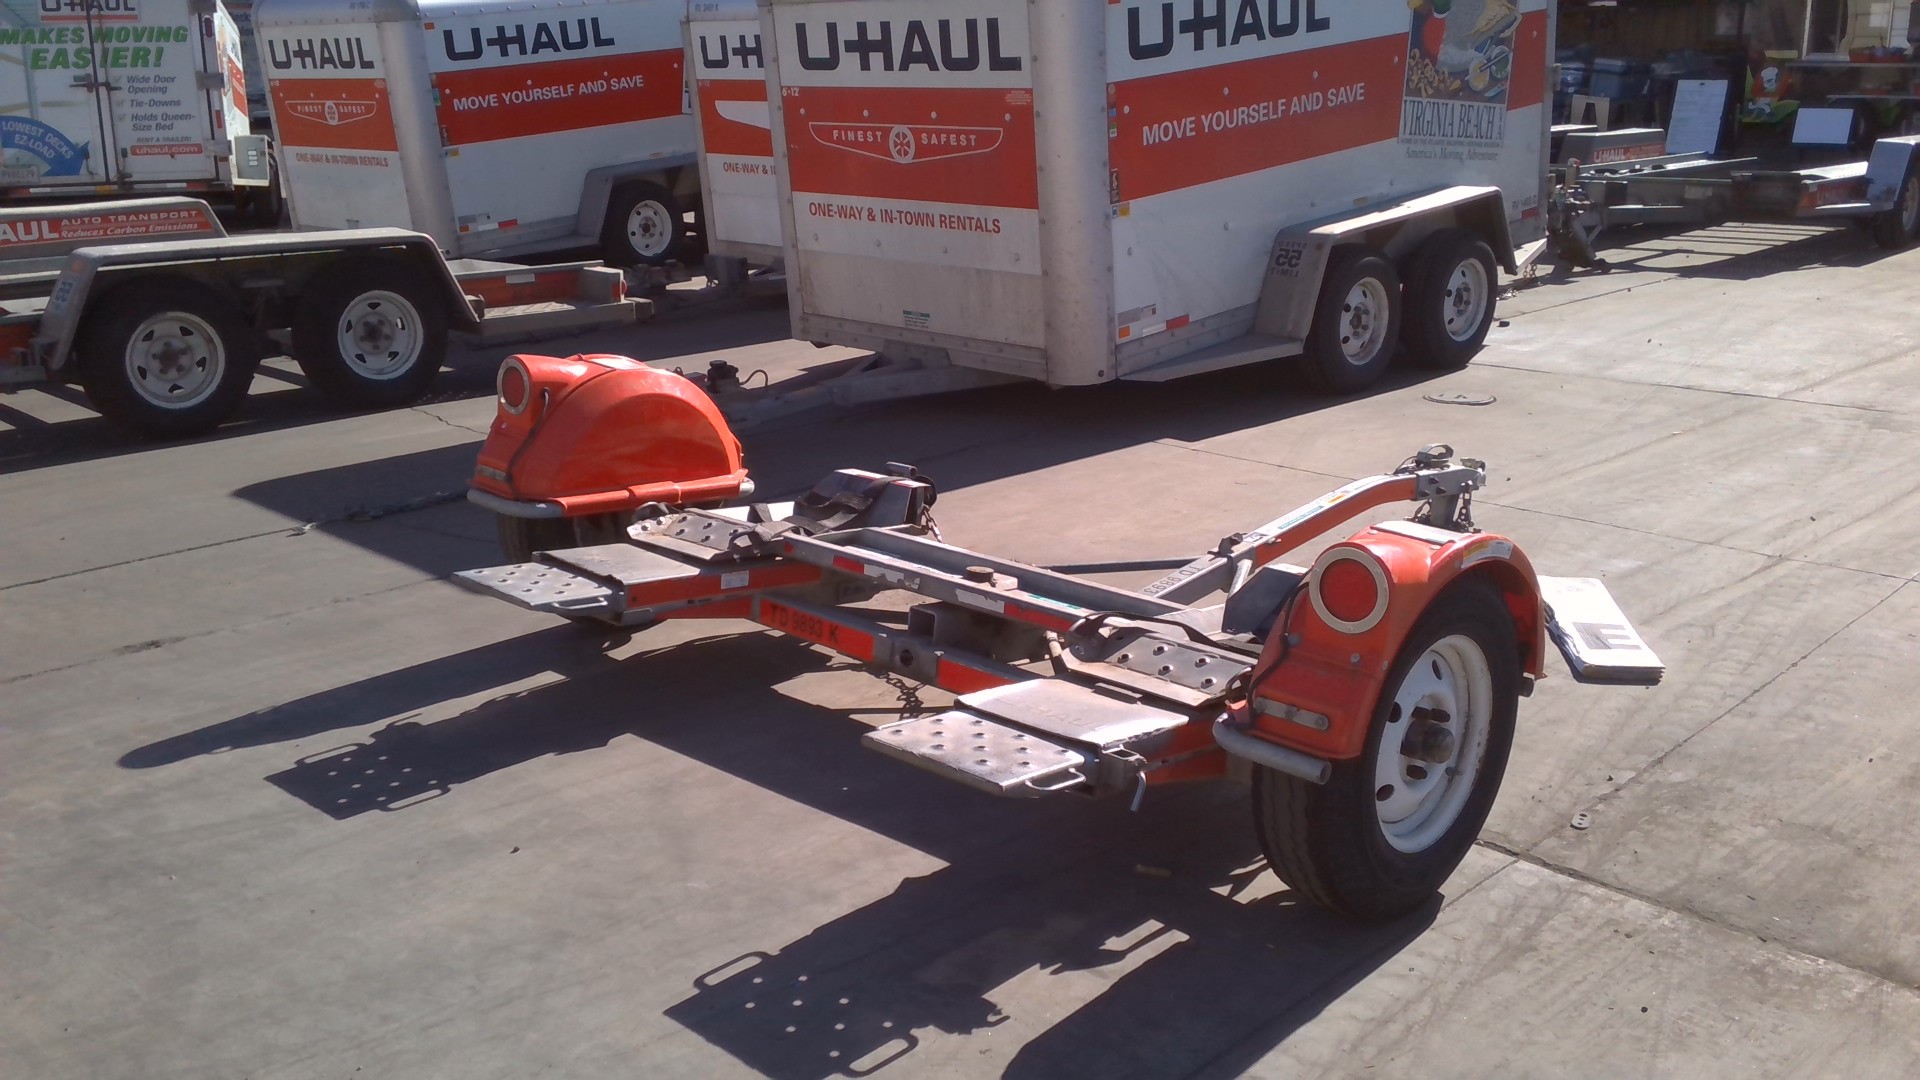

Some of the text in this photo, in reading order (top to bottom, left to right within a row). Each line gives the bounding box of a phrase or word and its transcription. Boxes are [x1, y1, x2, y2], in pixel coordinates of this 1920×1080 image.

[0, 26, 189, 45] MAKES MOVING
[442, 16, 616, 62] U-HAUL
[1127, 0, 1331, 61] U-HAUL
[268, 37, 375, 70] U-HAUL
[795, 17, 1023, 72] U-HAUL
[30, 47, 164, 70] EASIER!
[127, 75, 176, 83] Wide Door
[127, 85, 168, 95] Opening
[453, 75, 644, 111] MOVE YOURSELF AND SAVE
[130, 99, 181, 108] Tie-Downs
[131, 112, 196, 121] Holds Queen-
[1142, 82, 1365, 146] MOVE YOURSELF AND SAVE
[1403, 100, 1455, 138] VIRGINIA
[1457, 103, 1497, 139] BEACH
[132, 122, 174, 131] Size Bed
[2, 120, 74, 159] LOWEST DECKS
[832, 129, 977, 146] FINEST SAFEST
[136, 146, 198, 154] uhaul.com
[1593, 148, 1626, 163] U-HAUL
[359, 156, 389, 167] RENTALS
[723, 162, 760, 174] ONE-WAY
[762, 164, 768, 174] &
[61, 216, 102, 226] AUTO
[108, 211, 198, 222] TRANSPORT
[808, 202, 1001, 234] ONE-WAY & IN-TOWN RENTALS
[61, 222, 198, 239] Reduces Carbon Emissions
[1143, 576, 1182, 595] 9893
[770, 603, 788, 627] TD
[829, 621, 840, 644] K
